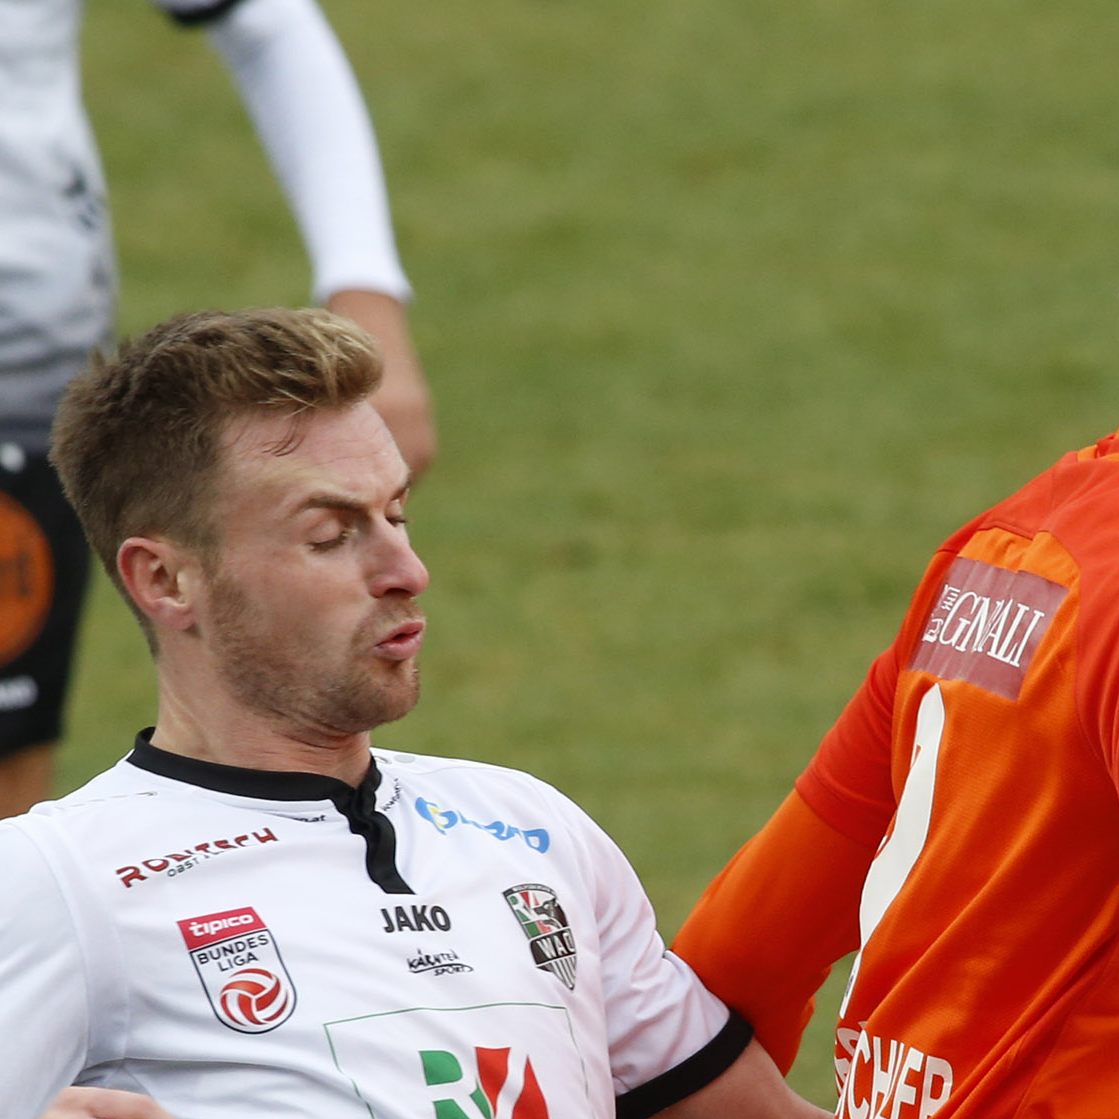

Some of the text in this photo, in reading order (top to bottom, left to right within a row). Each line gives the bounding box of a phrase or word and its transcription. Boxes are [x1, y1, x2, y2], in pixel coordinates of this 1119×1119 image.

[188, 913, 256, 937] tipico
[380, 904, 452, 934] JAKO
[196, 934, 270, 966] BUNDES
[217, 951, 259, 972] LIGA
